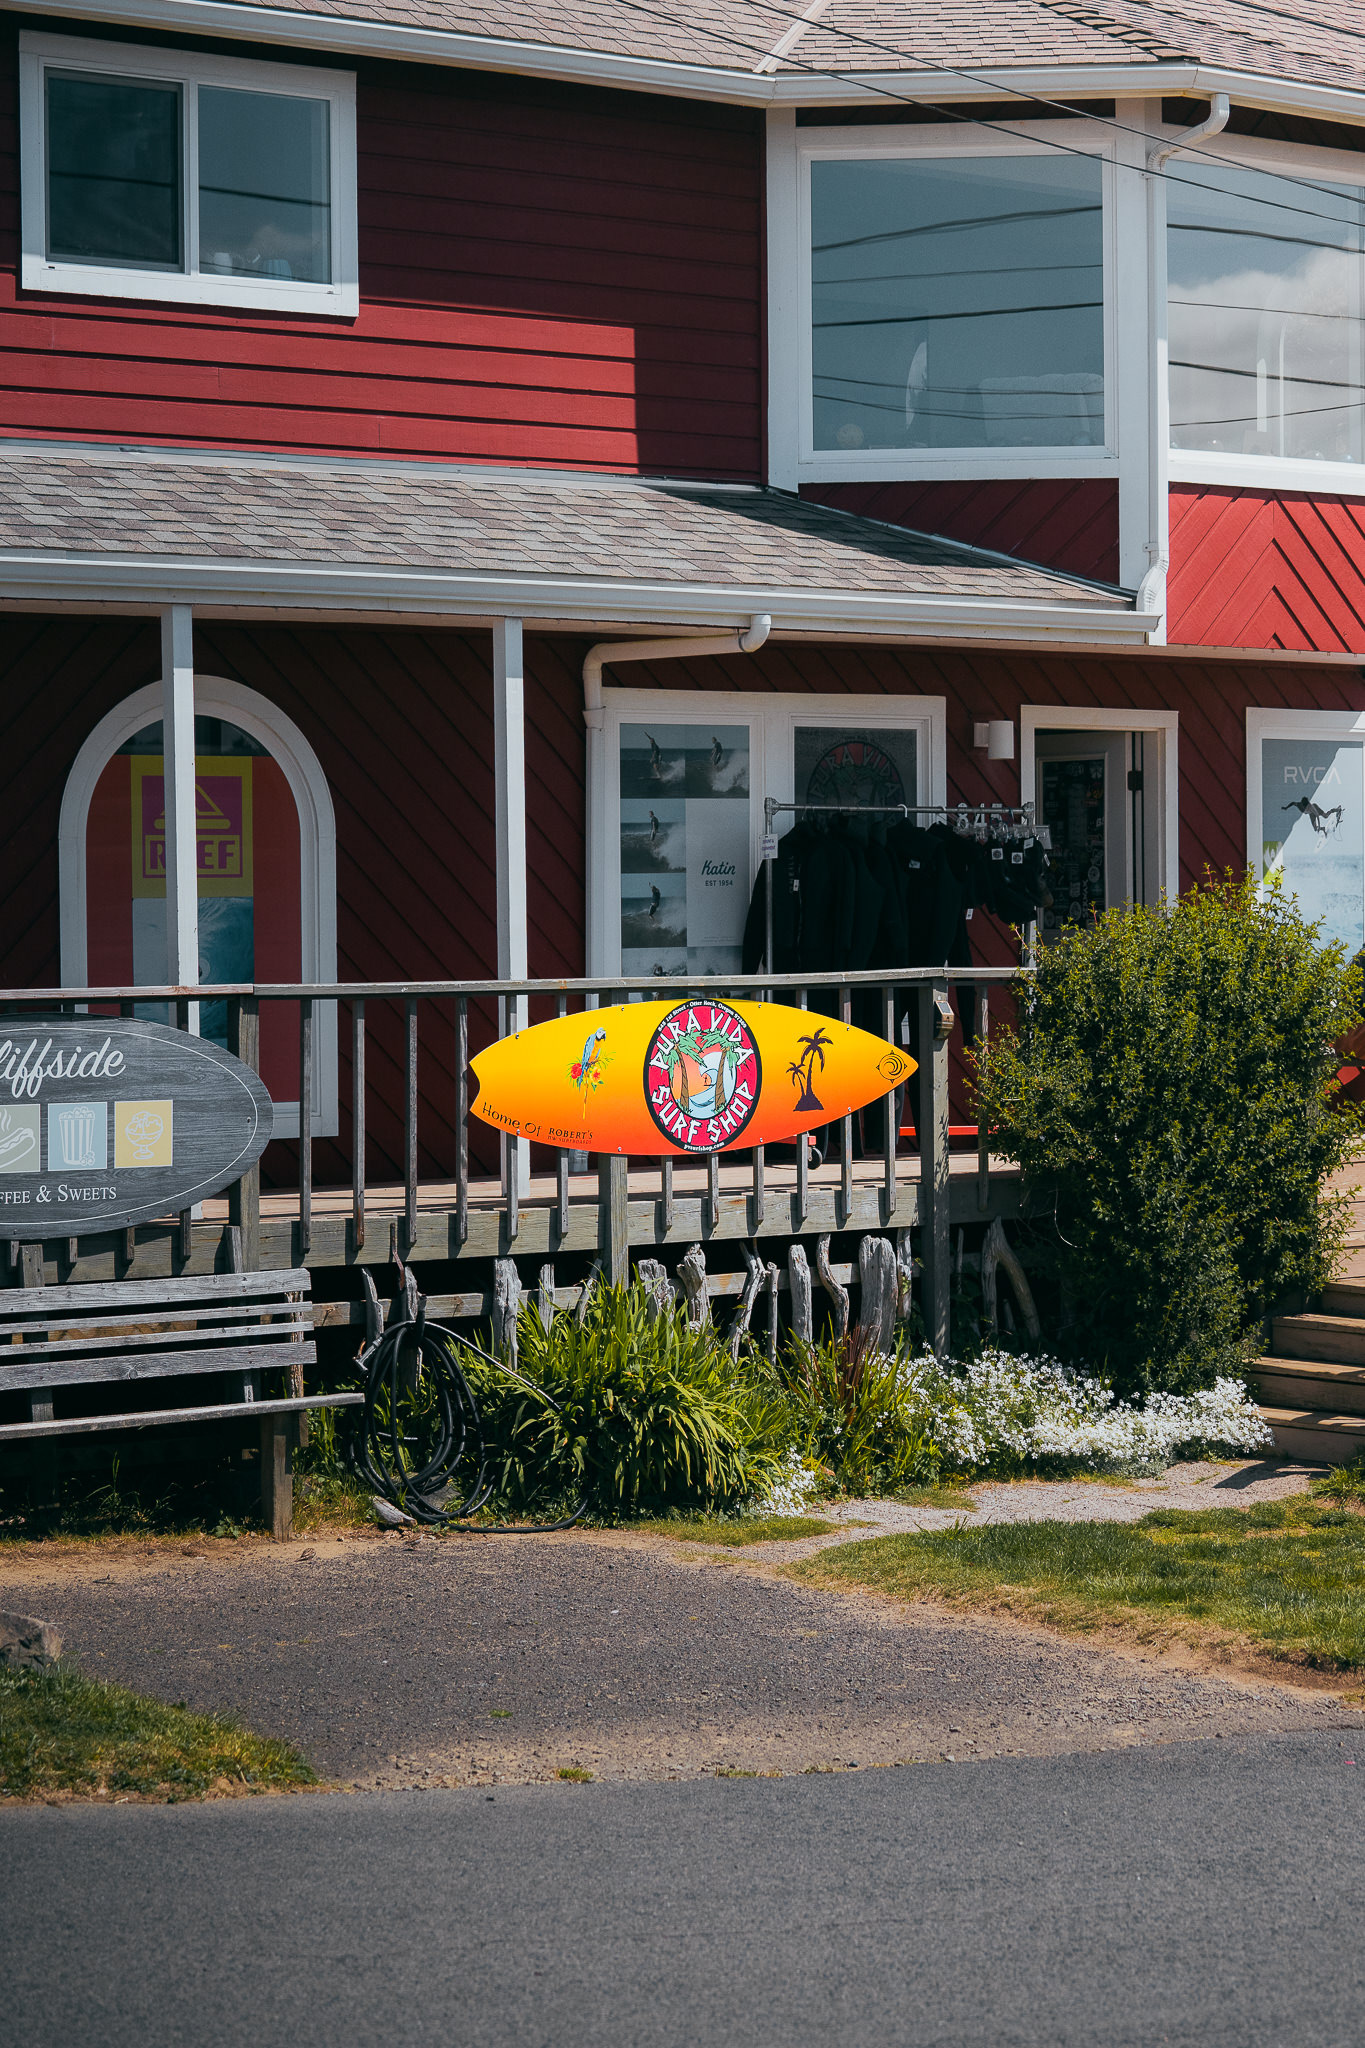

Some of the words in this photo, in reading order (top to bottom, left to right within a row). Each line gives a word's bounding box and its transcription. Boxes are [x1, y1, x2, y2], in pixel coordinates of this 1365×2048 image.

[1284, 766, 1342, 784] RVCA
[149, 840, 236, 870] REF
[701, 860, 736, 876] Katin
[717, 1003, 734, 1016] Oregon
[649, 1007, 701, 1070] PURA
[709, 1007, 754, 1066] VIDA
[0, 1037, 127, 1098] liffside
[482, 1101, 521, 1128] Home
[524, 1122, 542, 1137] Of
[651, 1085, 702, 1144] SURF
[706, 1080, 754, 1143] SHOP
[548, 1127, 593, 1139] ROBERT'S
[0, 1190, 31, 1205] FFEE
[36, 1184, 52, 1203] &
[57, 1184, 117, 1204] SWEETS
